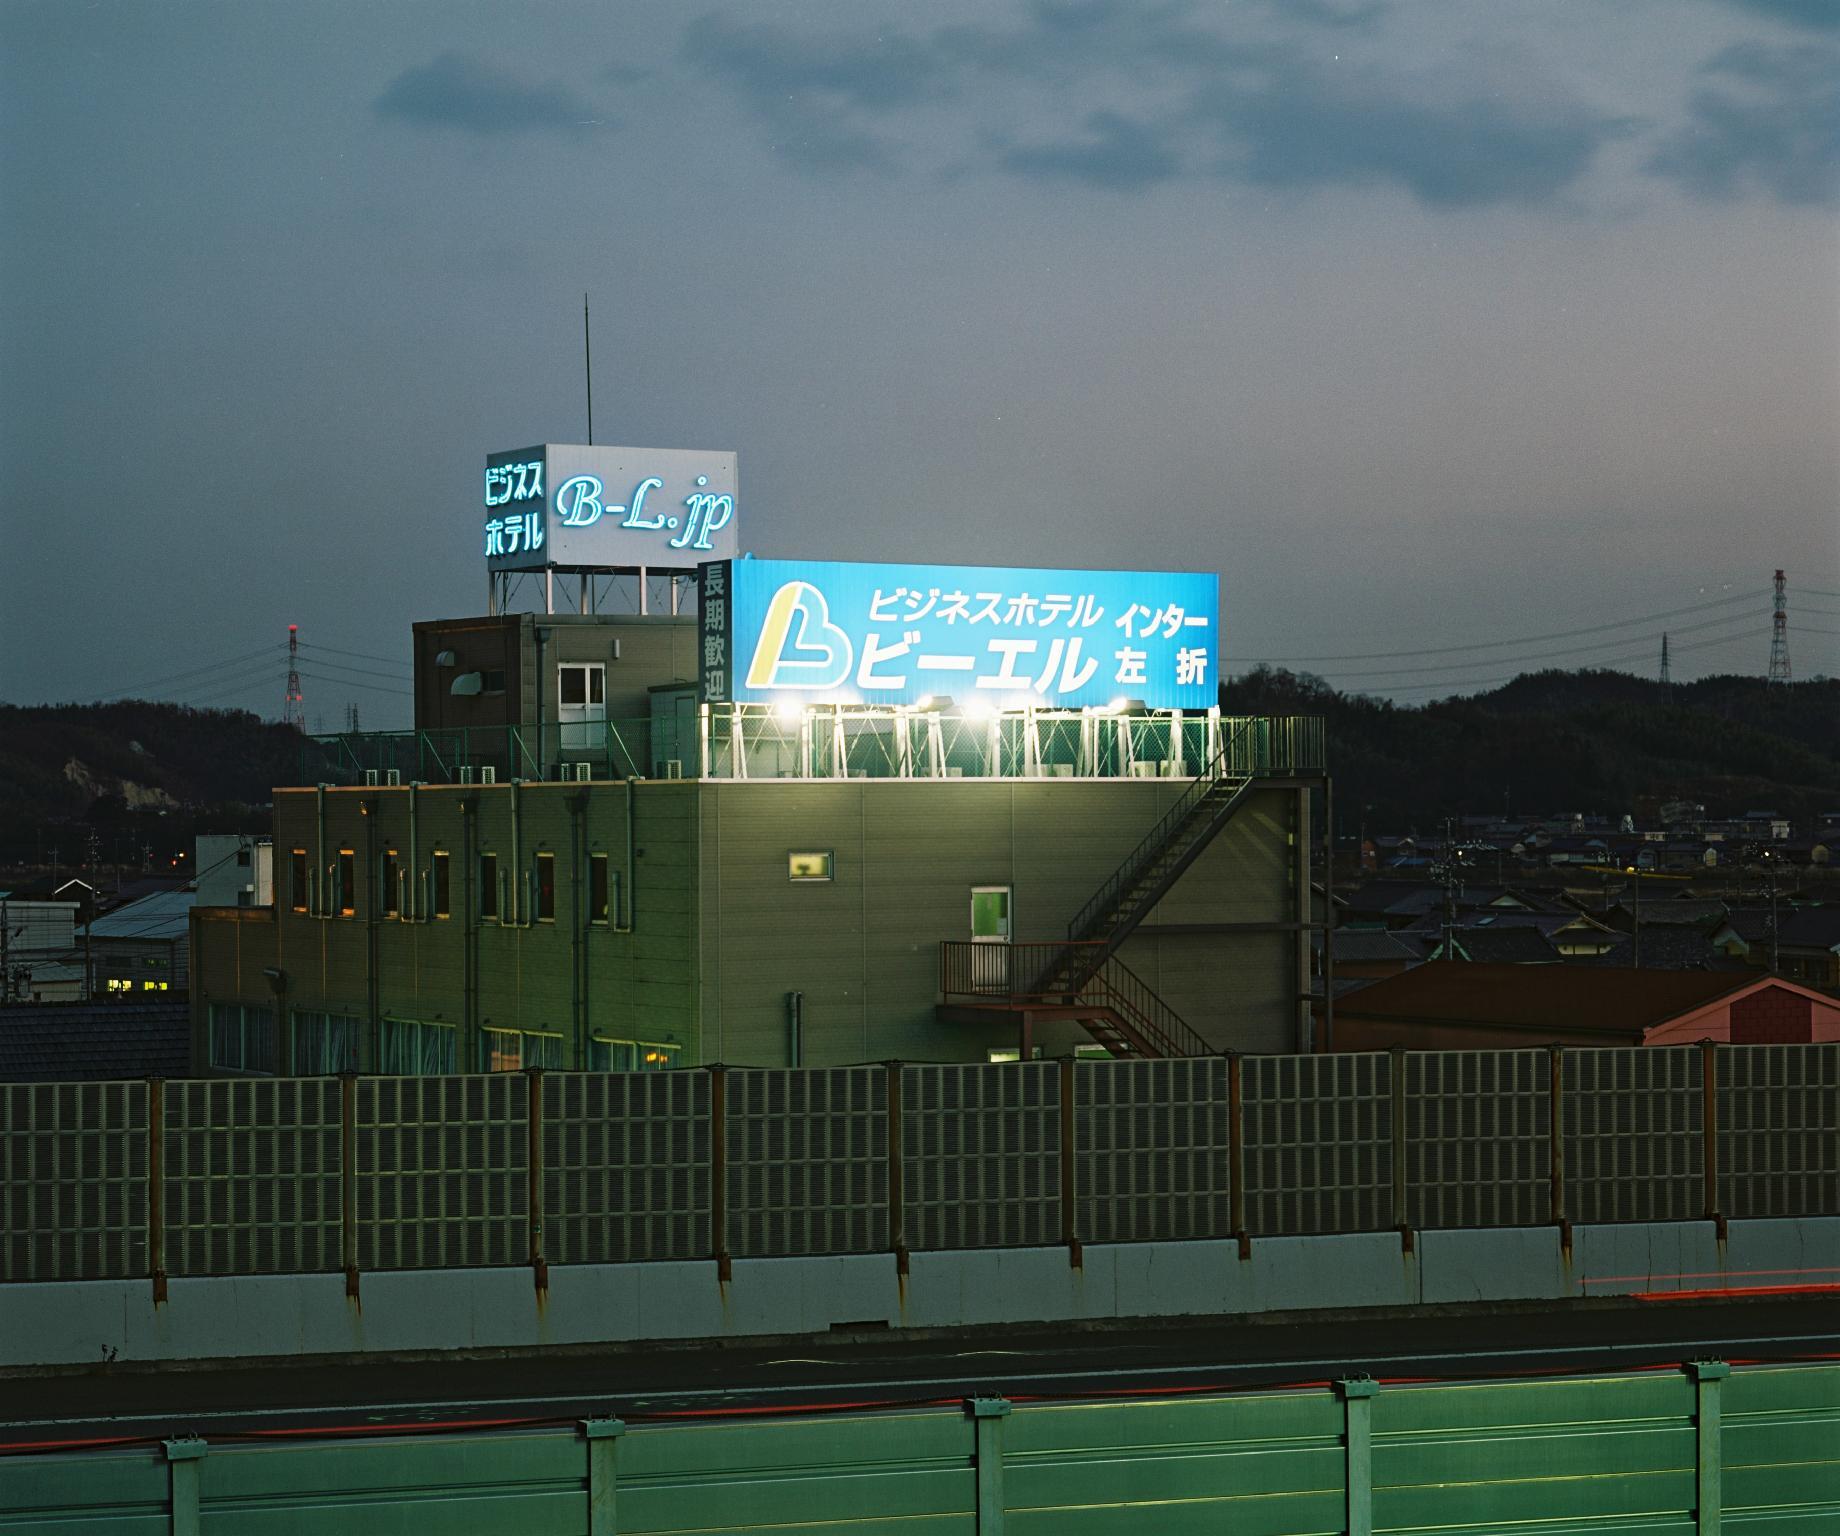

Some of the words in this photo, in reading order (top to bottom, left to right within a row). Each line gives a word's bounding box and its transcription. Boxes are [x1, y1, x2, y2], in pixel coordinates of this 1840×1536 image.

[486, 462, 543, 506] ビジネス
[557, 475, 734, 549] B-L.jp
[485, 513, 543, 557] ホテル
[868, 587, 1104, 629] ビジネスホテル
[1114, 603, 1208, 639] インター
[704, 564, 725, 701] 長期歓迎
[856, 630, 1099, 695] ビーエル
